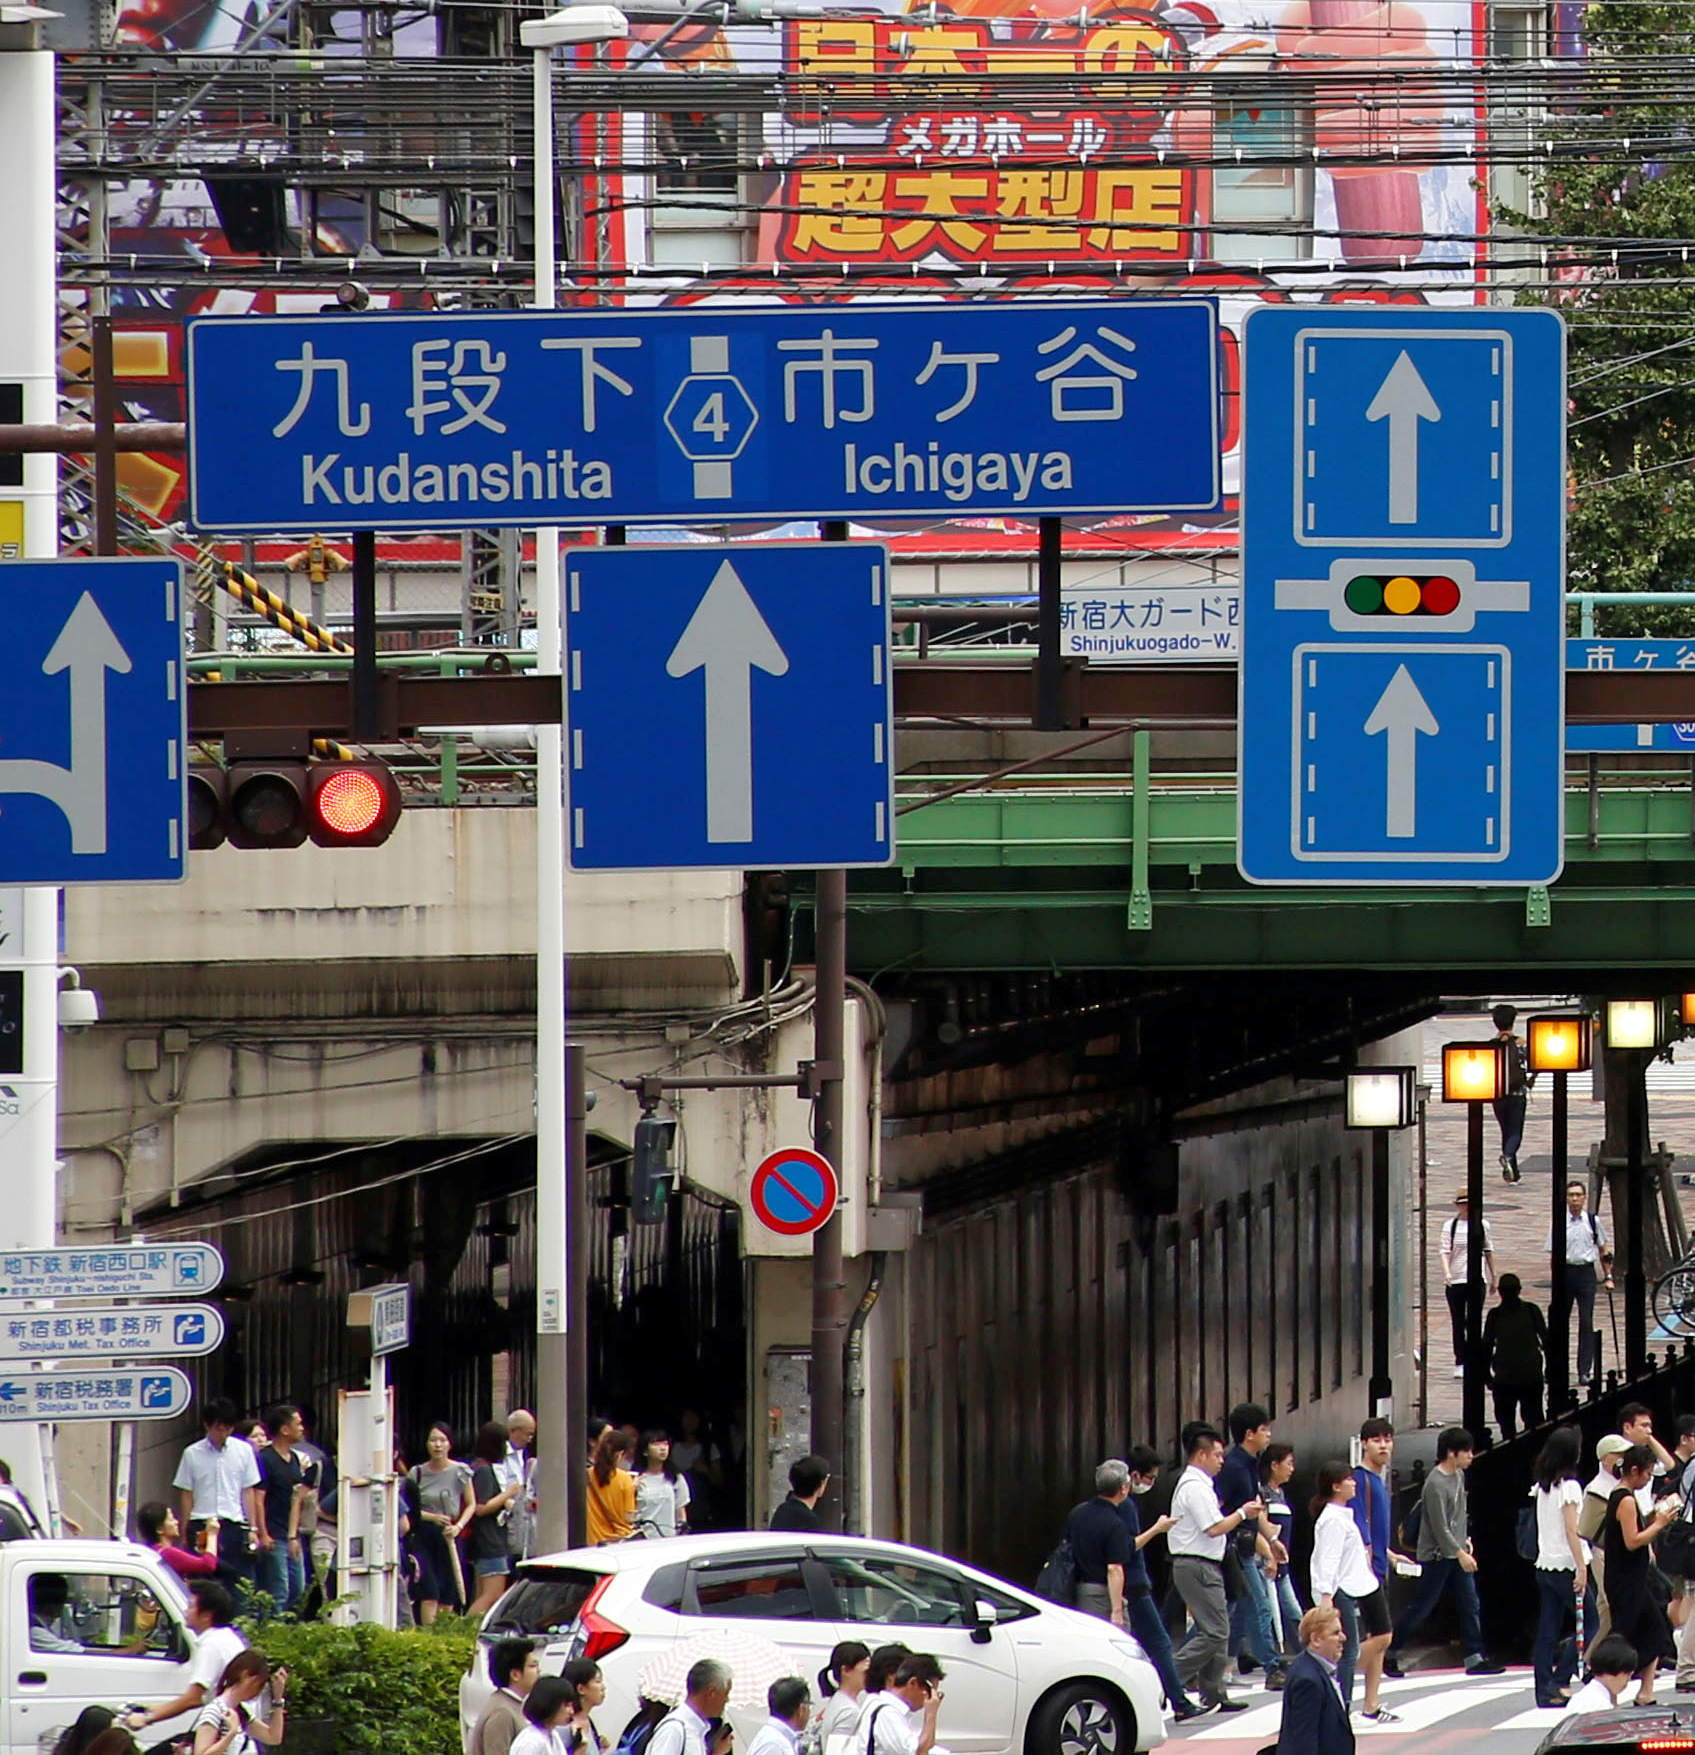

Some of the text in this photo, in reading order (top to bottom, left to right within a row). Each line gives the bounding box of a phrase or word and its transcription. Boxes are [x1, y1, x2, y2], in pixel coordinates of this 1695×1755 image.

[898, 118, 1106, 157] メガホール
[791, 169, 1182, 253] 超大型店
[273, 336, 643, 438] 九段下
[692, 392, 731, 443] 4
[302, 450, 613, 506] Kudanshita
[844, 442, 1074, 503] Ichigaya
[1070, 633, 1238, 654] Shinjukuogado-W.
[4, 1251, 167, 1275] 地下鉄 新宿西口駅
[8, 1316, 163, 1338] 新宿都税事務所
[18, 1340, 65, 1352] Shinjuku
[95, 1338, 115, 1349] Tax
[119, 1337, 151, 1349] Office
[35, 1378, 133, 1400] 新宿税務署
[36, 1399, 132, 1413] Shinjuku Tax Office
